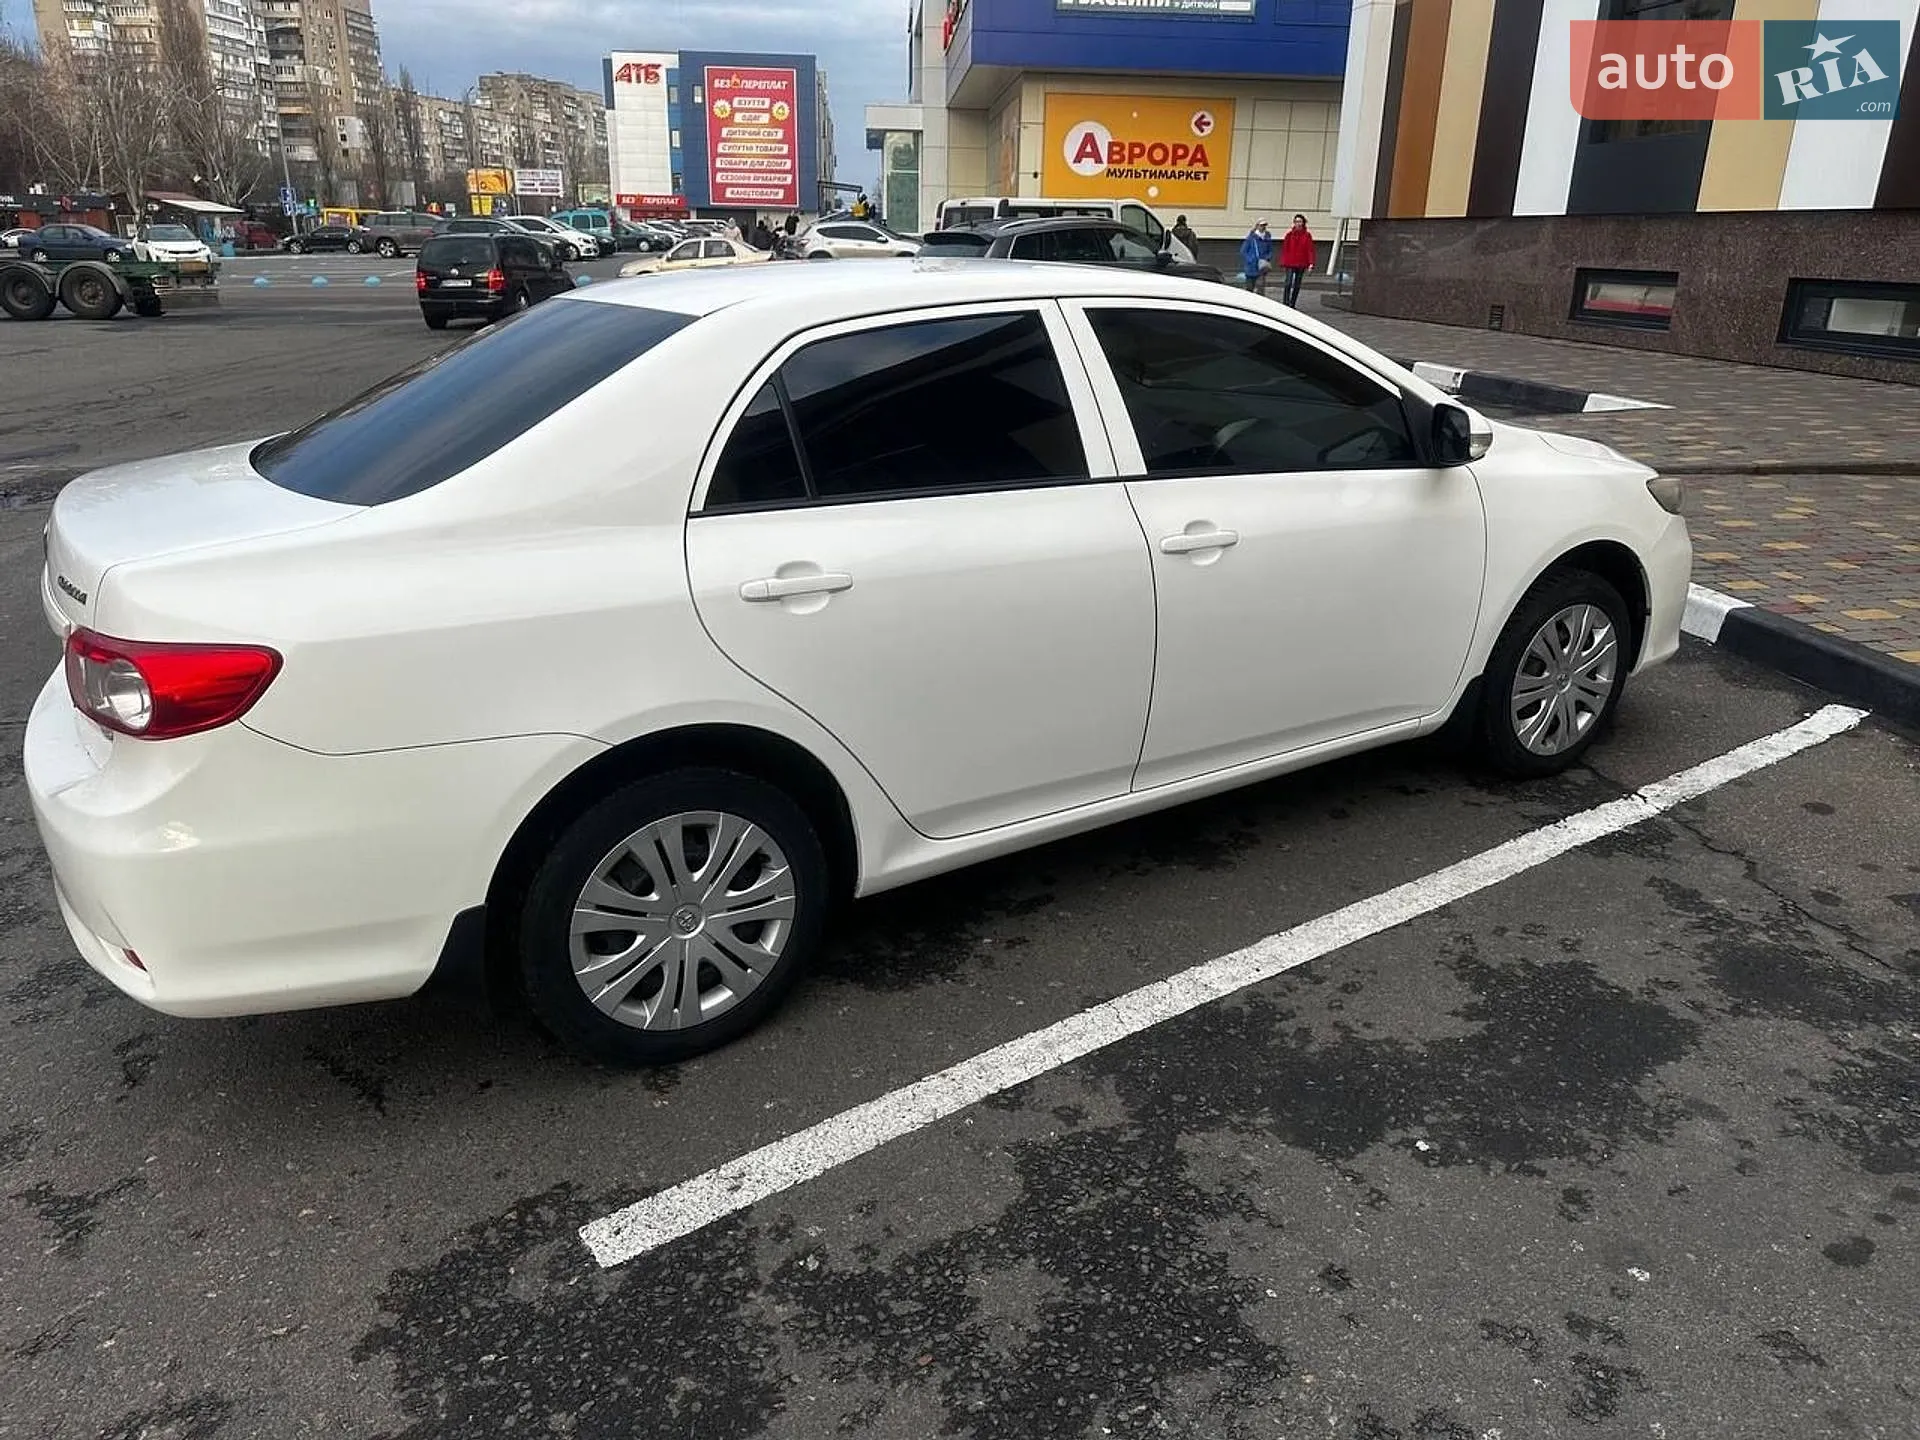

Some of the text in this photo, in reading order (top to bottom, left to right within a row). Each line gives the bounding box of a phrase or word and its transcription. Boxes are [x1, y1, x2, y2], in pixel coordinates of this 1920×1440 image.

[615, 63, 662, 84] АТБ
[1073, 132, 1210, 167] АВРОРА
[1106, 168, 1209, 181] МУЛЬТИМАРКЕТ
